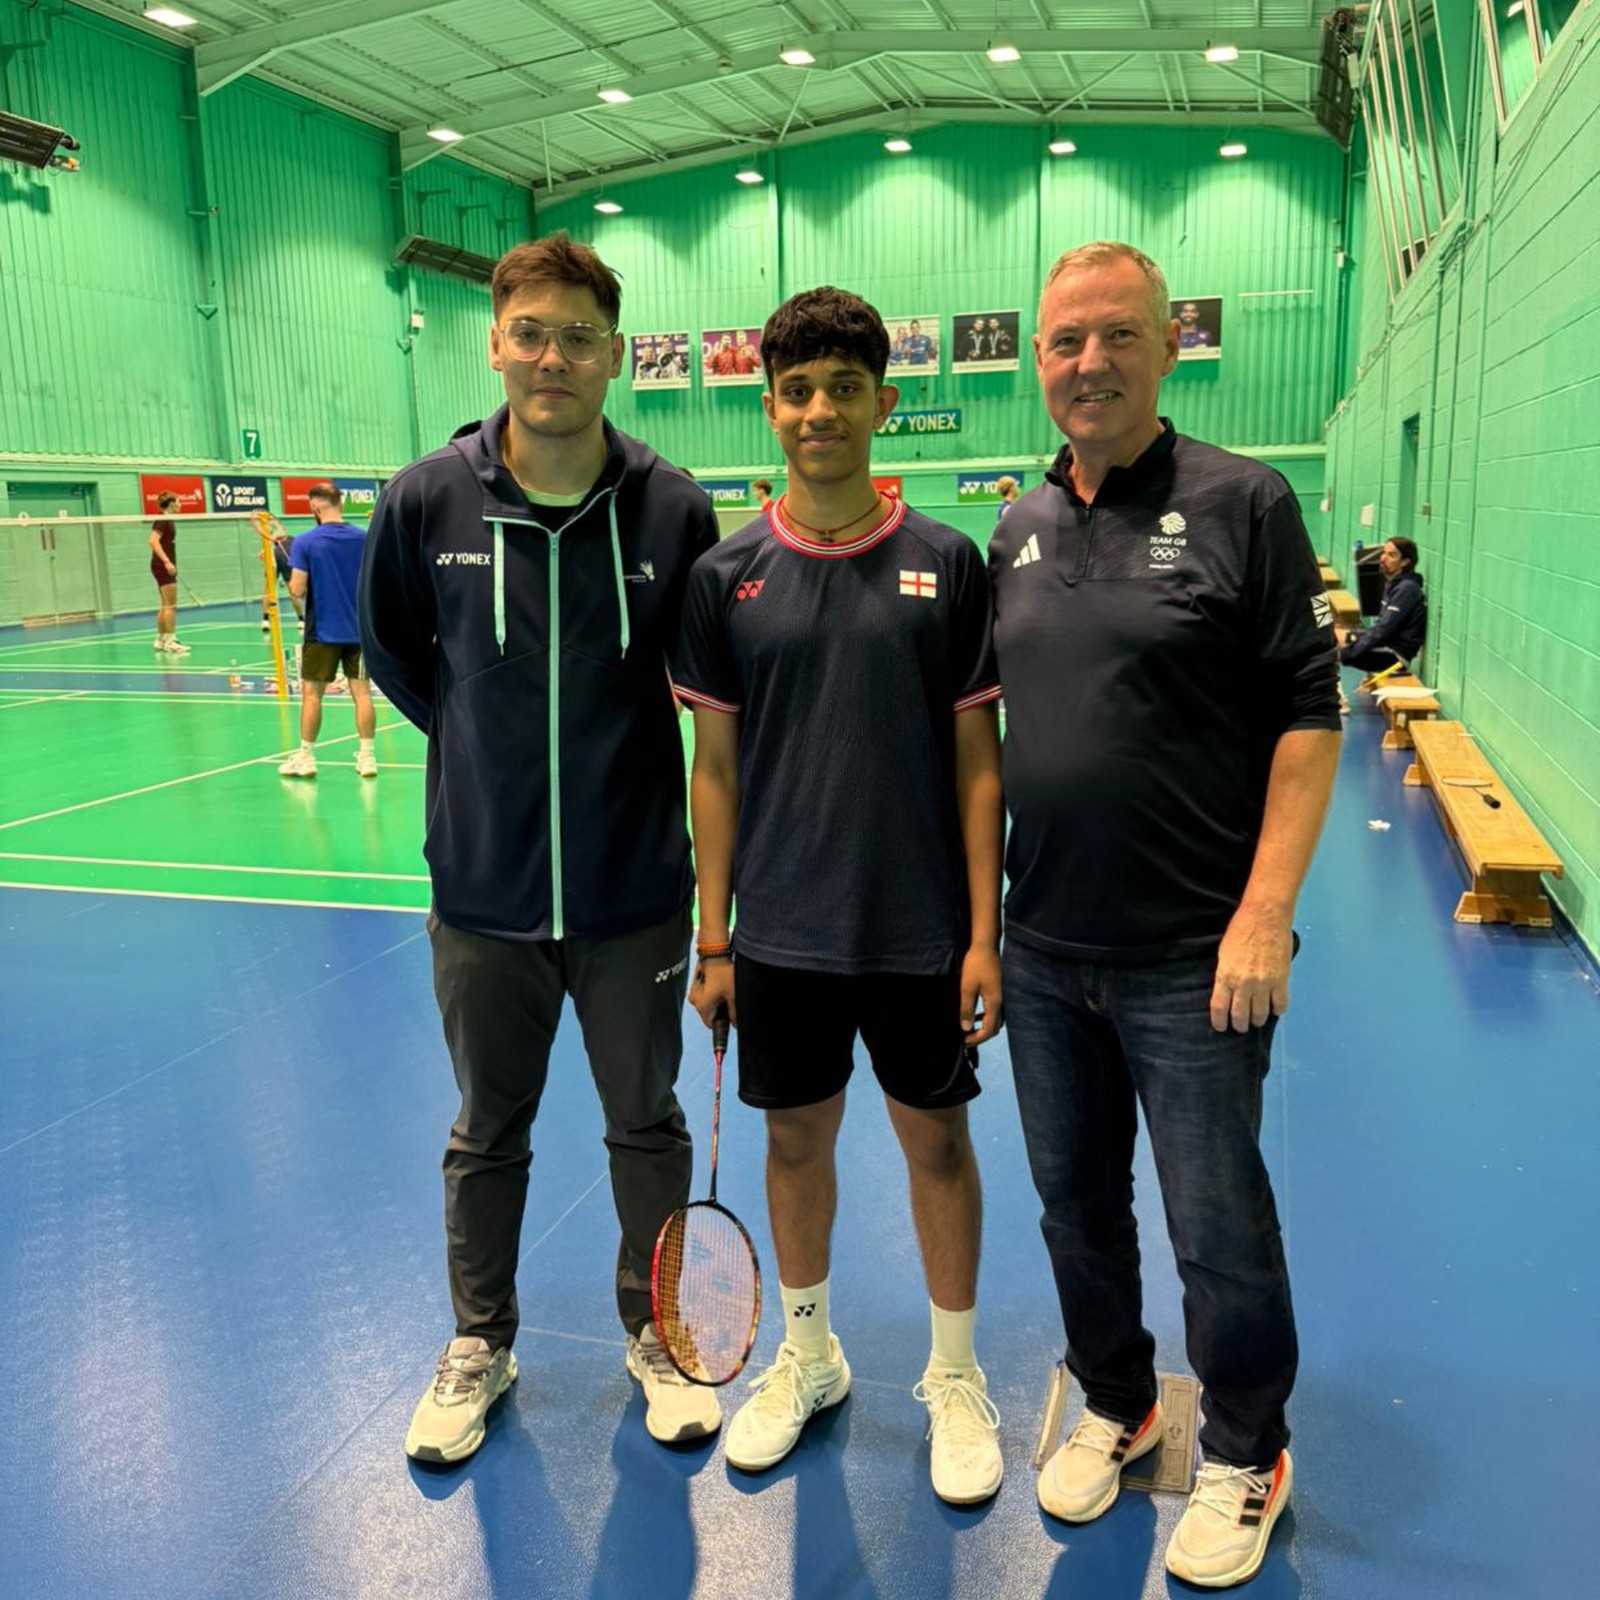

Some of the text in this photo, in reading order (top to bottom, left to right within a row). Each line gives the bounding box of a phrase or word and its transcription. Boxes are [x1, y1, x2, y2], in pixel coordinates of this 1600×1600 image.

[907, 412, 956, 432] YONEX
[246, 432, 256, 453] 7
[233, 486, 256, 496] SPORT
[350, 488, 375, 503] YONEX
[712, 488, 746, 501] YONEX
[234, 495, 266, 506] ENGLAND
[1150, 536, 1173, 545] TEAM
[455, 552, 491, 566] YONEX
